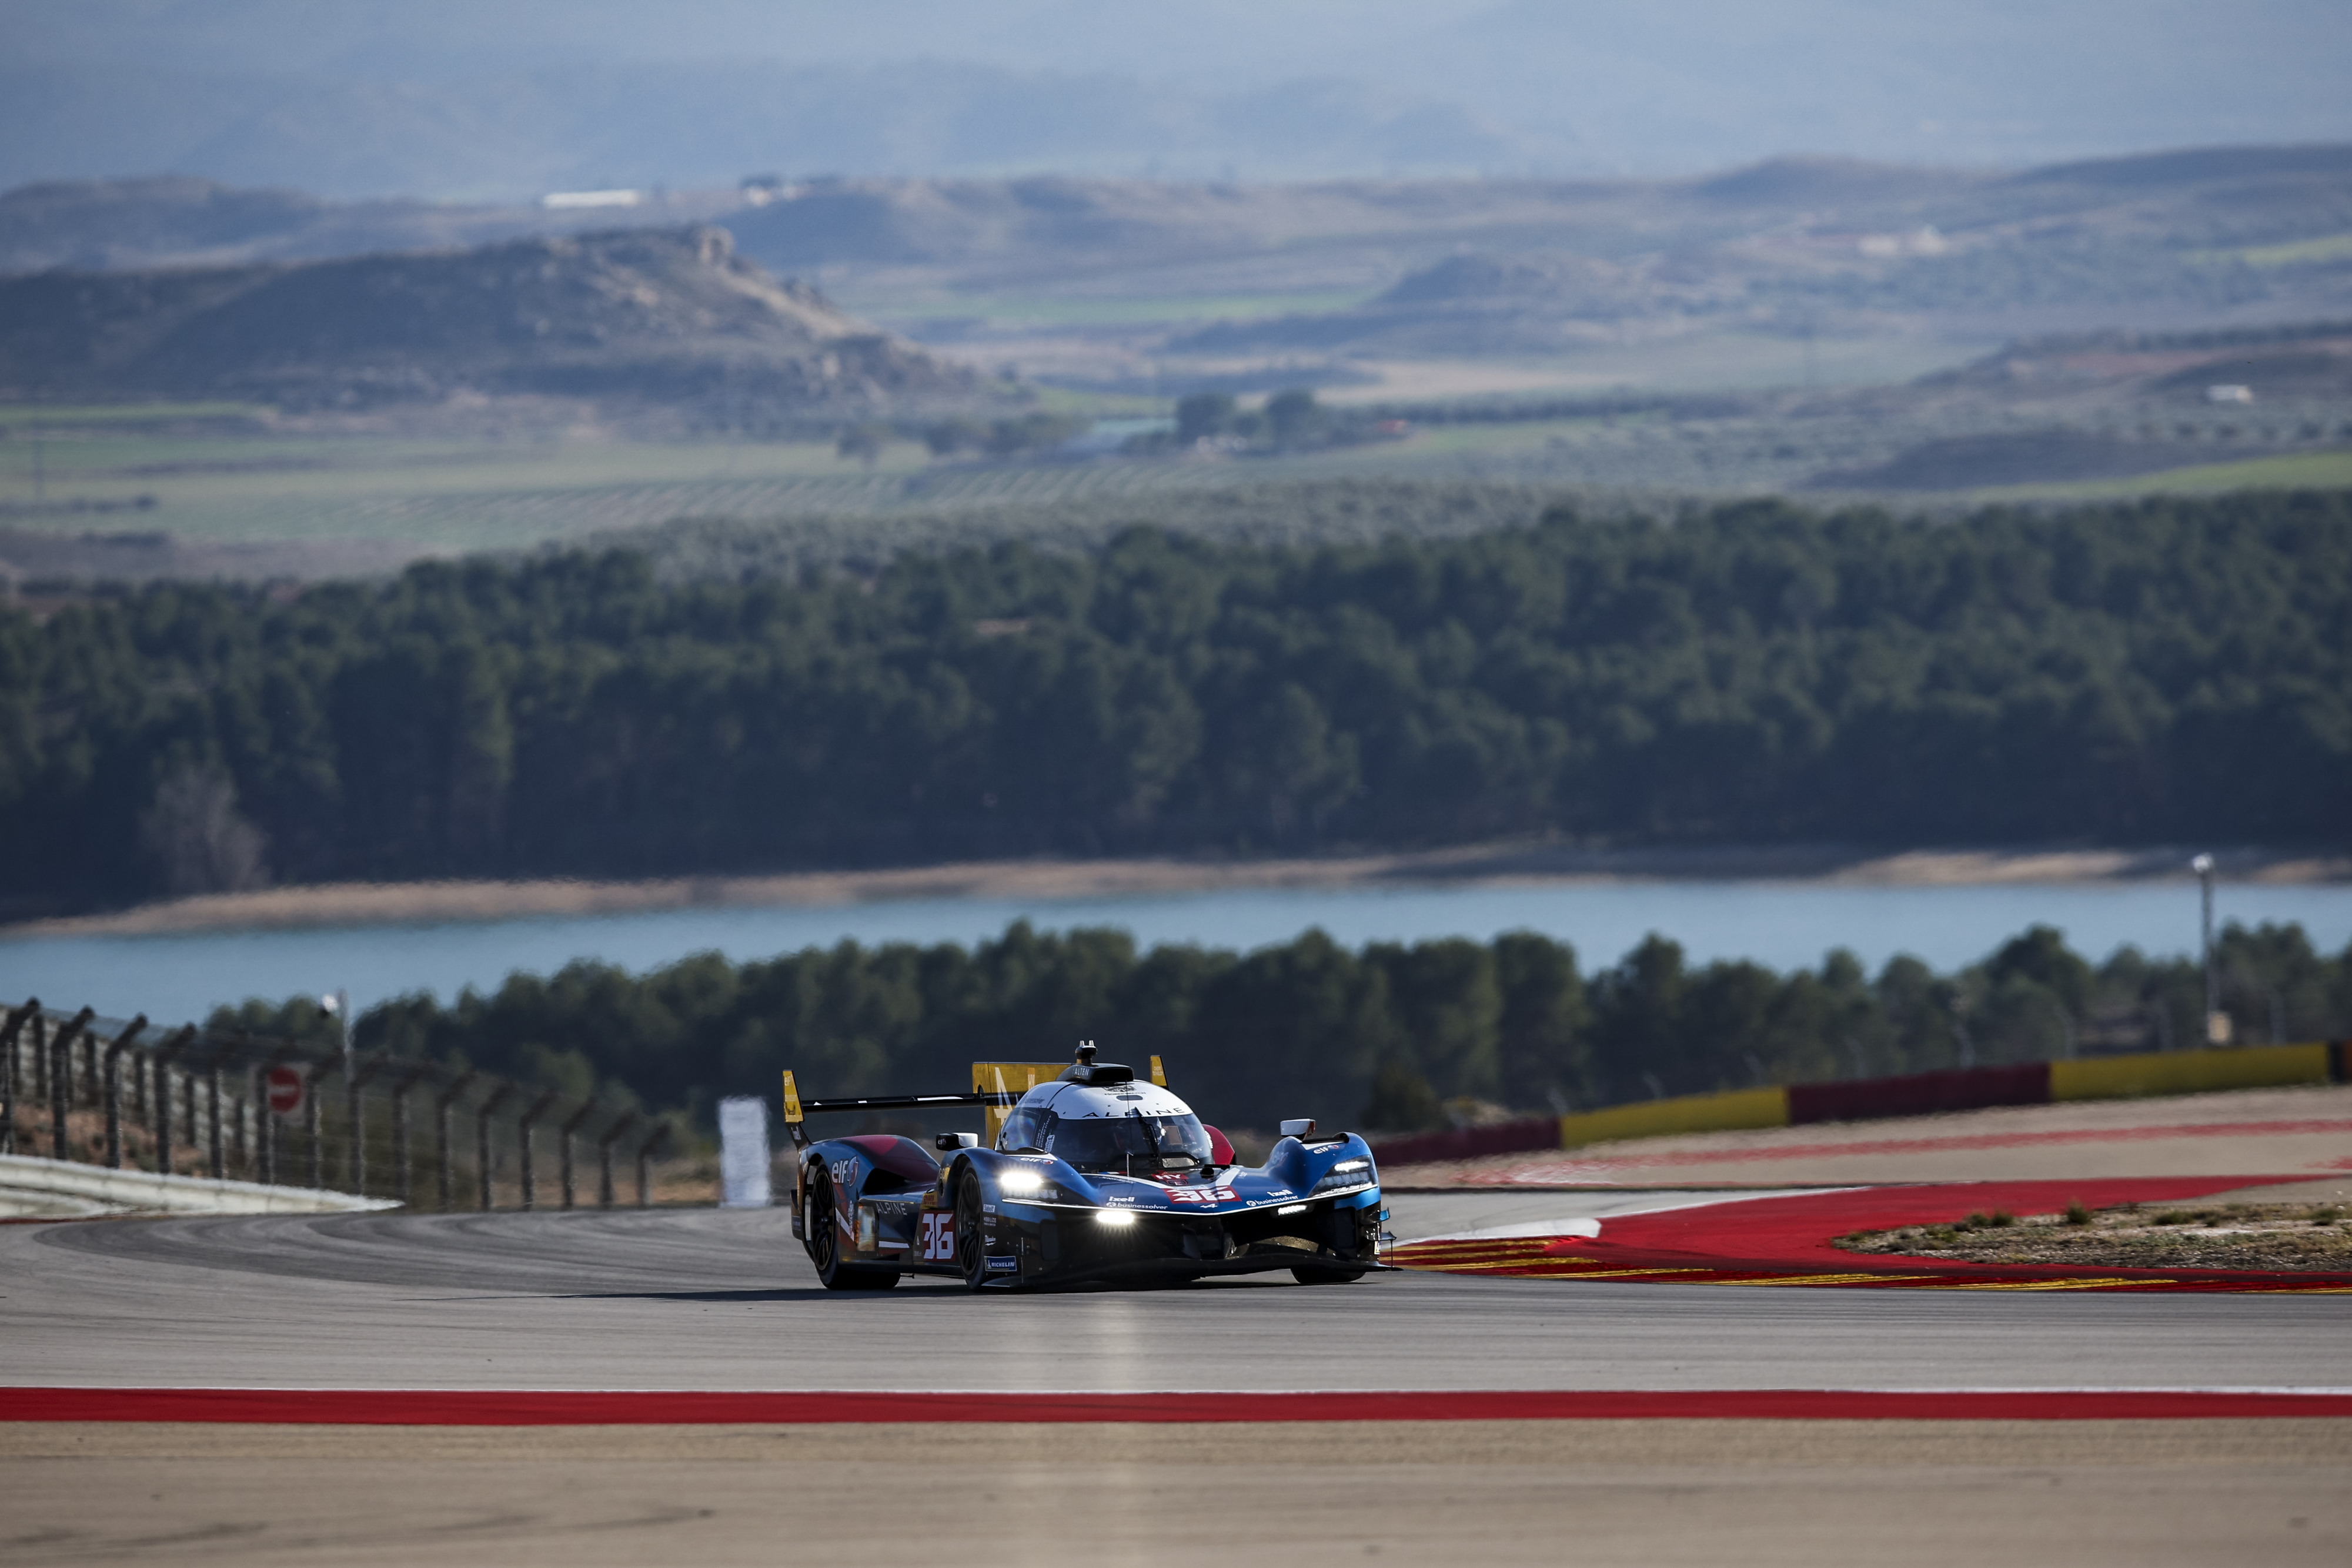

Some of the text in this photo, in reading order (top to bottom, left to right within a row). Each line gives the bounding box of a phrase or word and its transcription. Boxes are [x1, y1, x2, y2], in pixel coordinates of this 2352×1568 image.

[1074, 1068, 1090, 1076] ALTEN
[1082, 1107, 1185, 1118] ALPINE
[1313, 1146, 1330, 1155] elf
[831, 1159, 848, 1183] elf
[1166, 1186, 1236, 1202] 36
[1254, 1195, 1299, 1205] businessolver
[876, 1202, 908, 1216] ALPINE
[921, 1213, 954, 1259] 36
